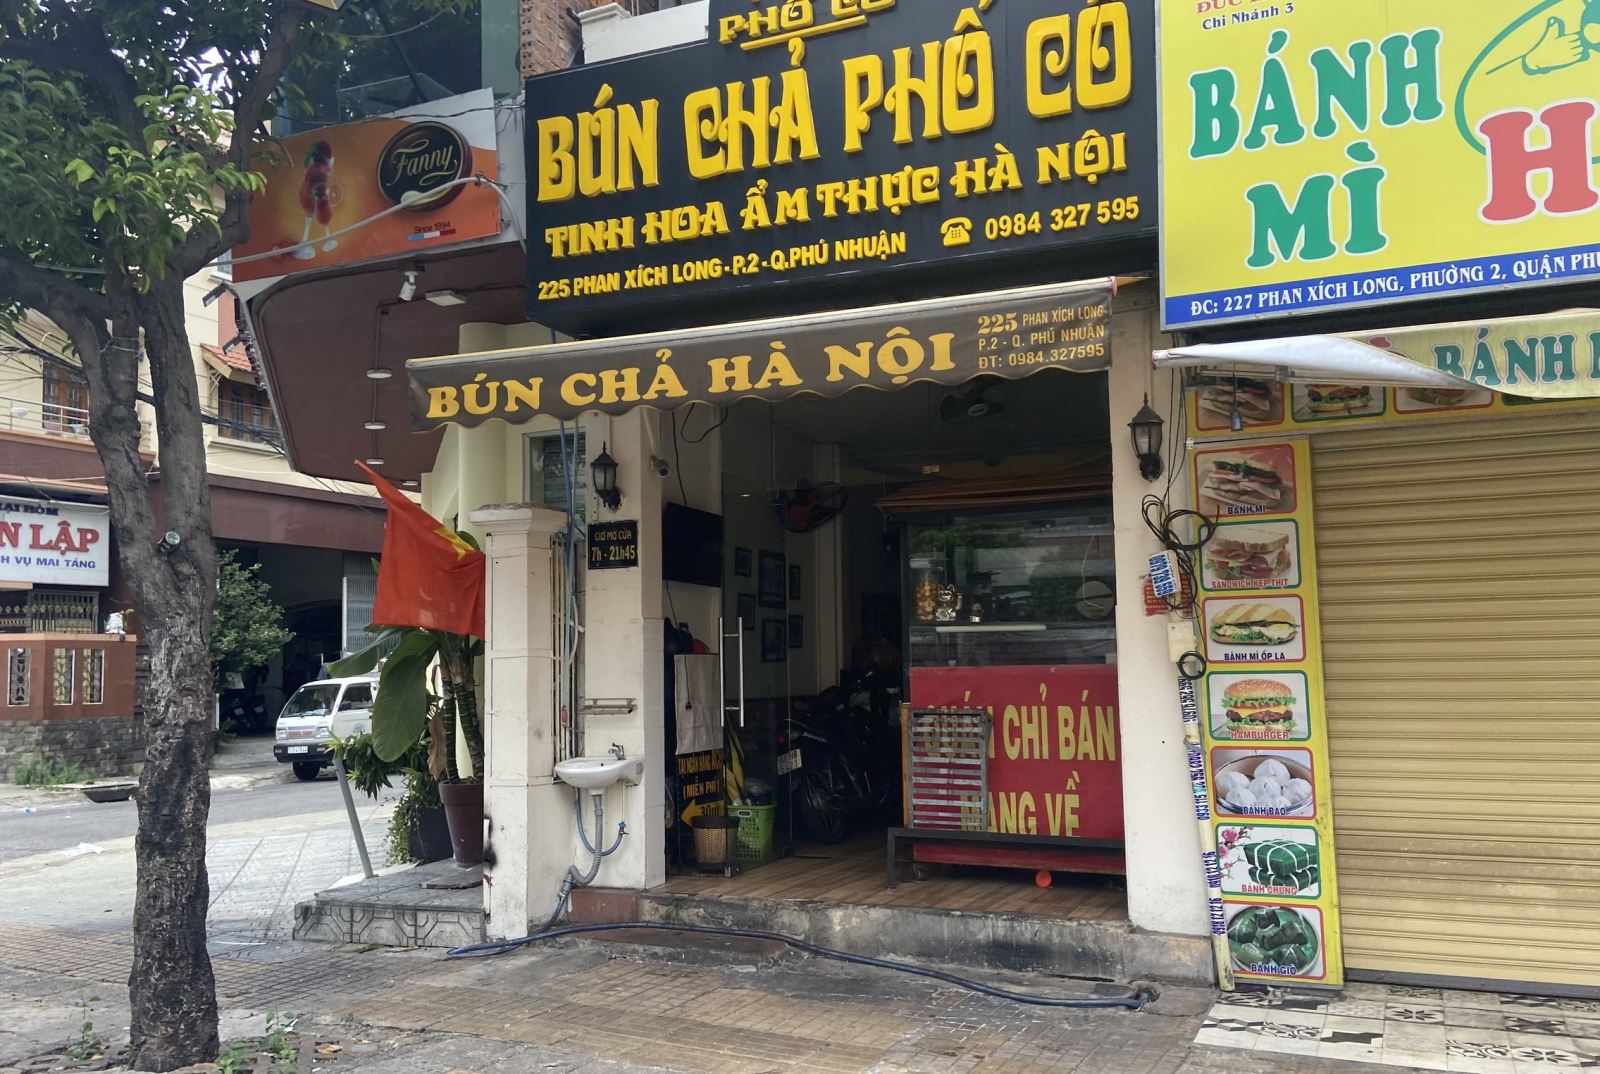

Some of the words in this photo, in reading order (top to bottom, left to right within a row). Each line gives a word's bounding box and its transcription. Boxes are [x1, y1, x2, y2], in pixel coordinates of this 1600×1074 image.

[1202, 15, 1226, 30] Chi
[1231, 6, 1279, 24] Nhánh
[1285, 2, 1294, 14] 3
[1189, 29, 1443, 158] BÁNH
[536, 83, 659, 202] BÚN
[683, 37, 821, 181] CHẢ
[388, 140, 456, 186] Fanny
[545, 216, 635, 258] TINH
[641, 201, 730, 244] HOA
[739, 178, 810, 230] ẨM
[816, 165, 940, 217] THỰC
[949, 143, 1024, 198] HÀ
[1036, 129, 1128, 185] NỘI
[1247, 141, 1387, 268] MÌ
[984, 211, 1041, 240] 0984
[1050, 203, 1092, 232] 327
[1096, 196, 1140, 224] 595
[538, 279, 570, 300] 225
[573, 272, 621, 297] PHAN
[624, 263, 668, 289] XÍCH
[835, 230, 906, 261] NHUẬN
[1191, 299, 1218, 316] ĐC:
[1223, 294, 1253, 312] 227
[1258, 288, 1303, 309] PHAN
[1307, 279, 1348, 303] XÍCH
[1353, 275, 1404, 297] LONG,
[1410, 264, 1484, 290] PHƯỜNG
[1490, 263, 1507, 280] 2,
[1513, 254, 1566, 279] QUẬN
[978, 312, 1018, 334] 225
[1022, 311, 1048, 327] PHAN
[1052, 306, 1074, 322] XÍCH
[1078, 304, 1104, 320] LONG
[978, 337, 998, 350] P.2
[1030, 327, 1055, 345] PHÚ
[1061, 323, 1105, 342] NHUẬN
[425, 372, 544, 418] BÚN
[560, 347, 688, 406] CHẢ
[707, 340, 803, 393] HÀ
[823, 326, 955, 384] NỘI
[978, 355, 1002, 368] ĐT:
[1008, 343, 1104, 367] 0984.327595
[1433, 327, 1577, 385] BÁNH
[0, 502, 20, 514] ẠI
[23, 503, 60, 516] HÒM
[29, 520, 100, 555] LẬP
[591, 547, 602, 561] 7h
[609, 545, 636, 561] 21h45
[15, 556, 32, 567] VỤ
[36, 558, 59, 567] MAI
[64, 557, 96, 569] TÁNG
[1212, 579, 1251, 589] SANDWICH
[1224, 651, 1247, 661] BÁNH
[1003, 682, 1049, 760] CHỈ
[1057, 690, 1116, 761] BÁN
[1231, 731, 1289, 739] HAMBURGER
[1044, 770, 1081, 838] VỀ
[1268, 806, 1286, 816] BAO
